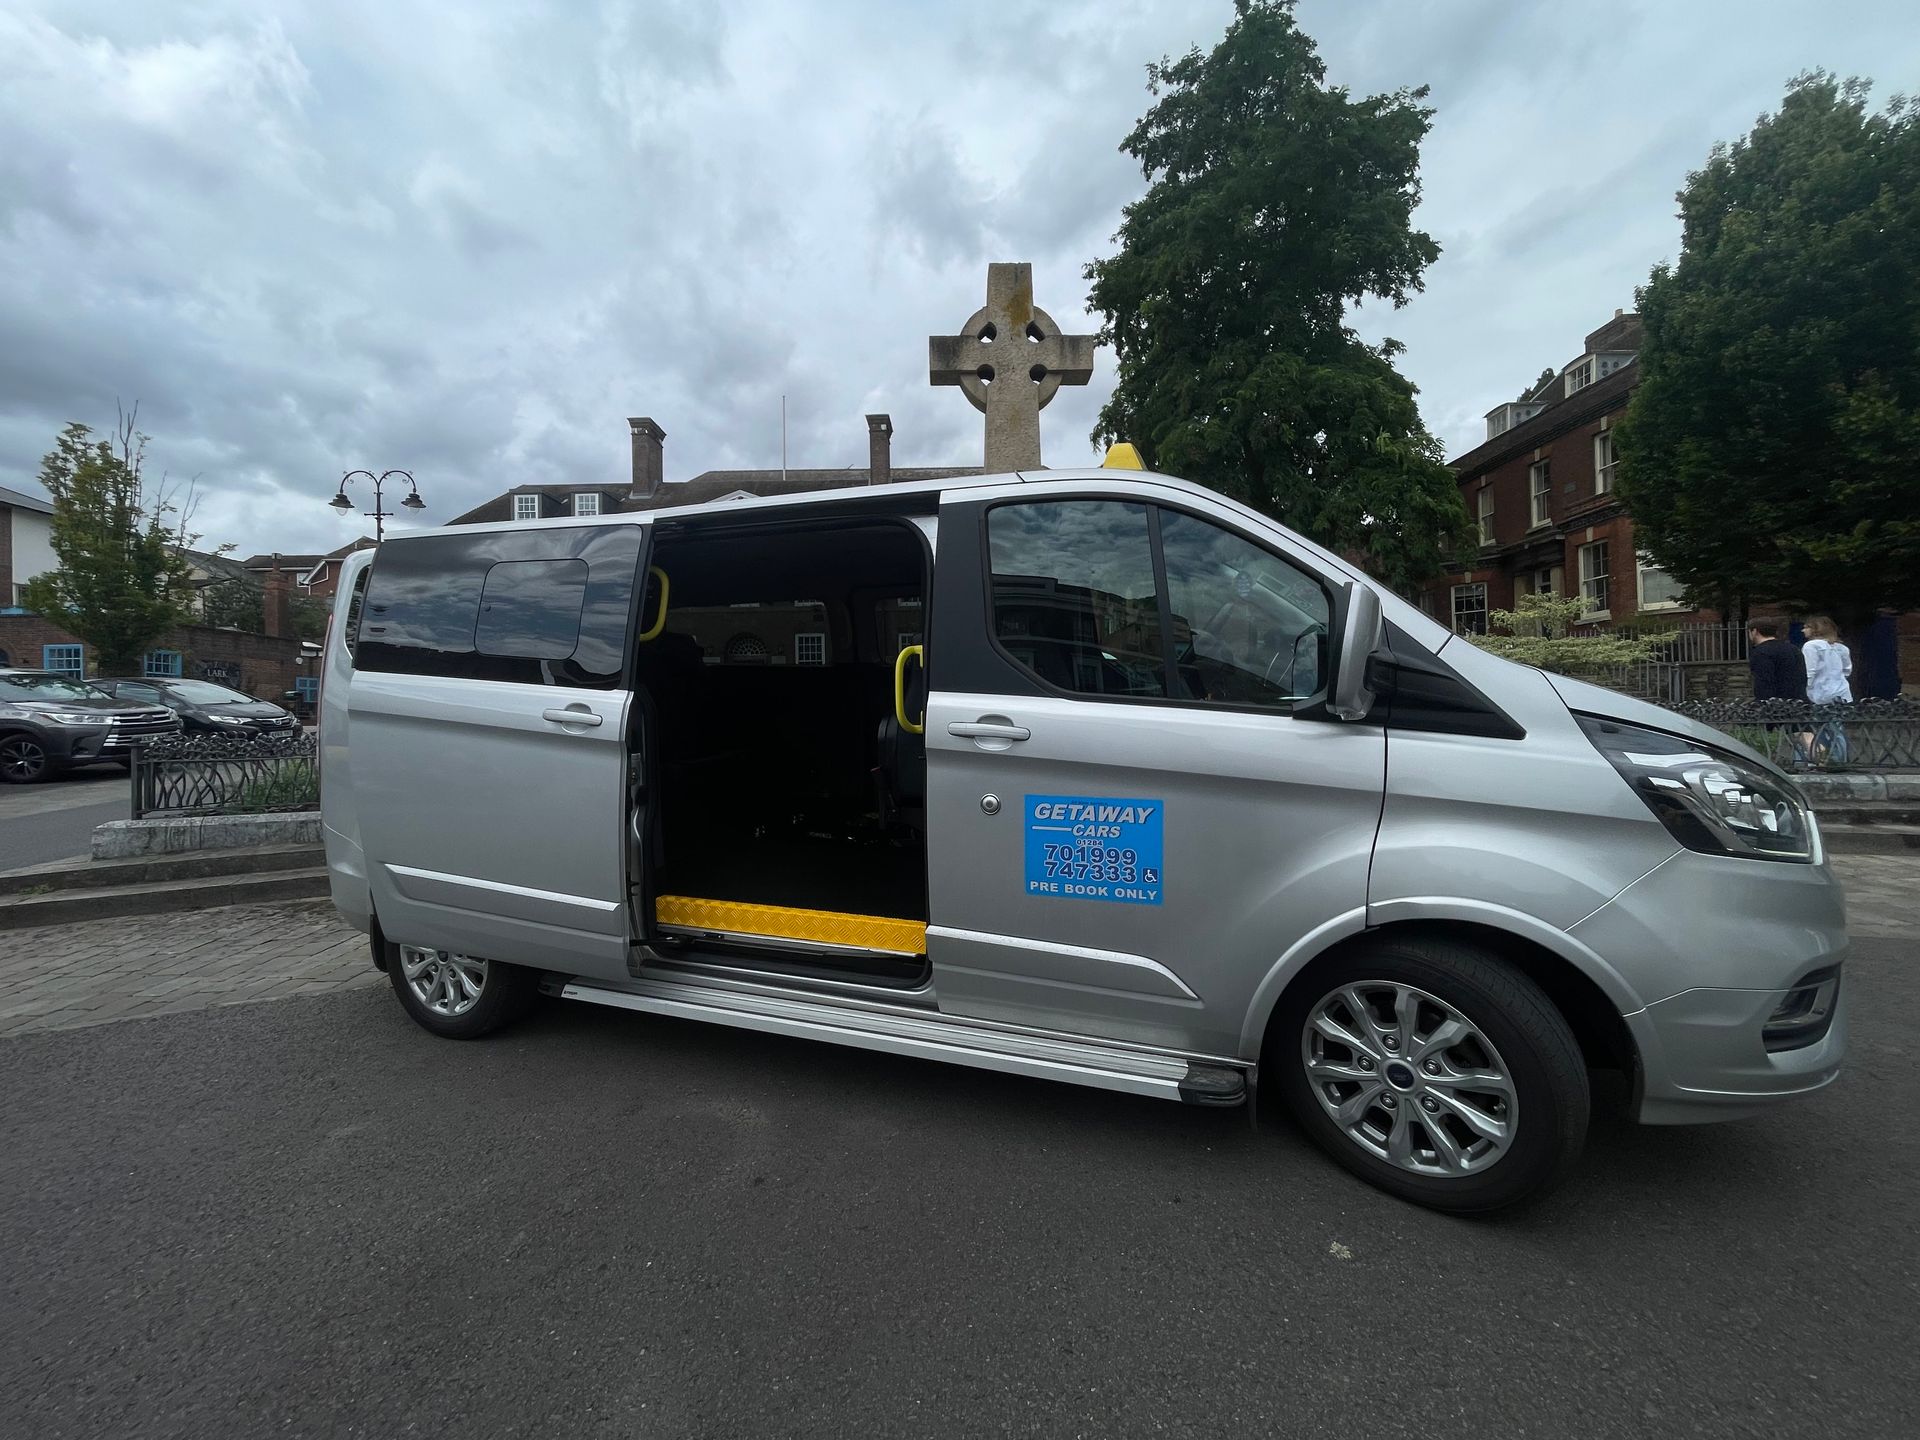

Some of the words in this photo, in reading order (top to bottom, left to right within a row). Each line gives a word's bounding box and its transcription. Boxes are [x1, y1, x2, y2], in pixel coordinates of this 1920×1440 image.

[1034, 803, 1154, 824] GETAWAY
[1072, 824, 1121, 838] CARS
[1076, 839, 1103, 847] 01284
[1044, 844, 1137, 865] 701999
[1044, 861, 1137, 884] 747333
[1030, 881, 1059, 892] PRE
[1064, 883, 1109, 897] BOOK
[1114, 887, 1158, 900] ONLY
